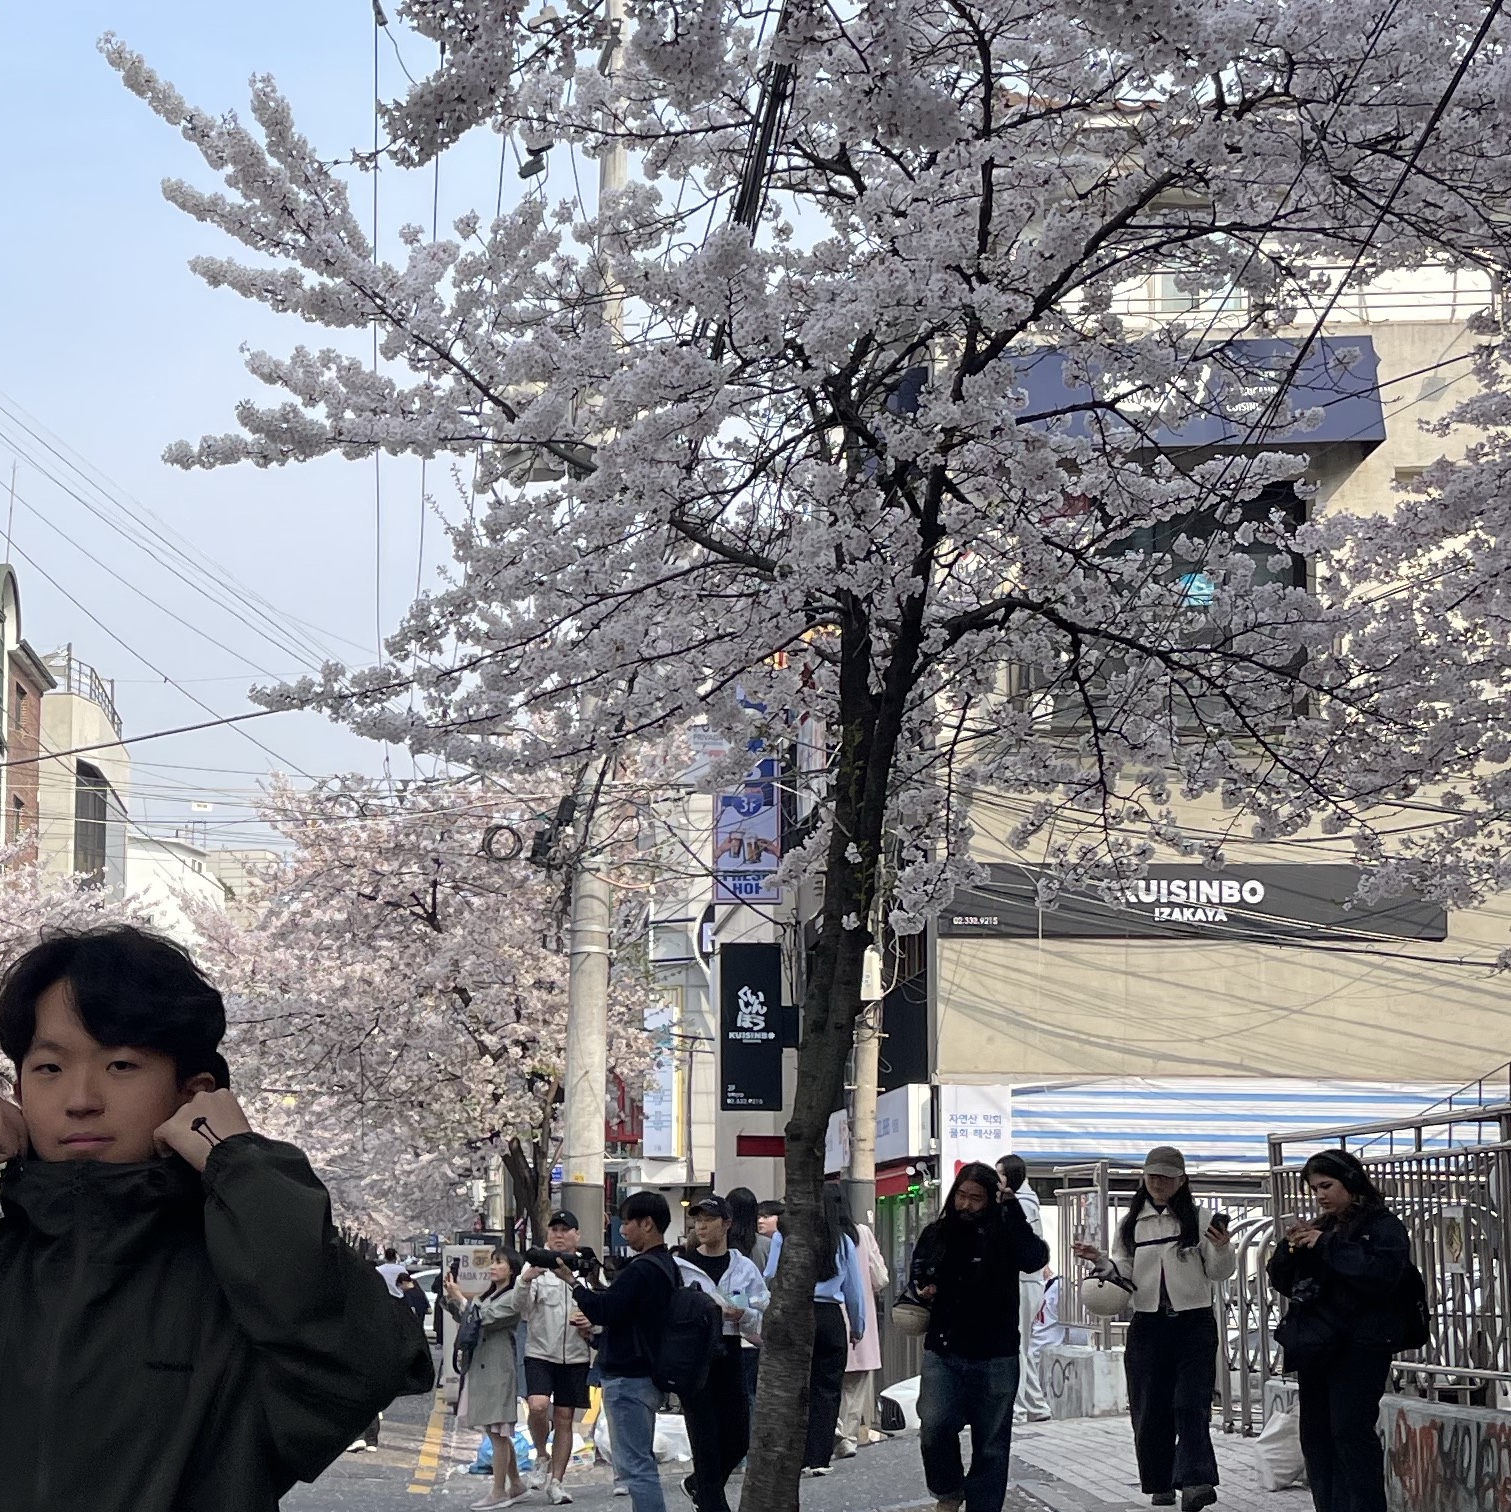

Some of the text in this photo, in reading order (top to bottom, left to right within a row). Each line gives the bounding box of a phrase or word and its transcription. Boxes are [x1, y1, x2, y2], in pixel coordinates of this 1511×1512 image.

[1154, 907, 1228, 921] IZAKAYA
[949, 1113, 977, 1125] 자연산
[446, 1255, 469, 1268] PB
